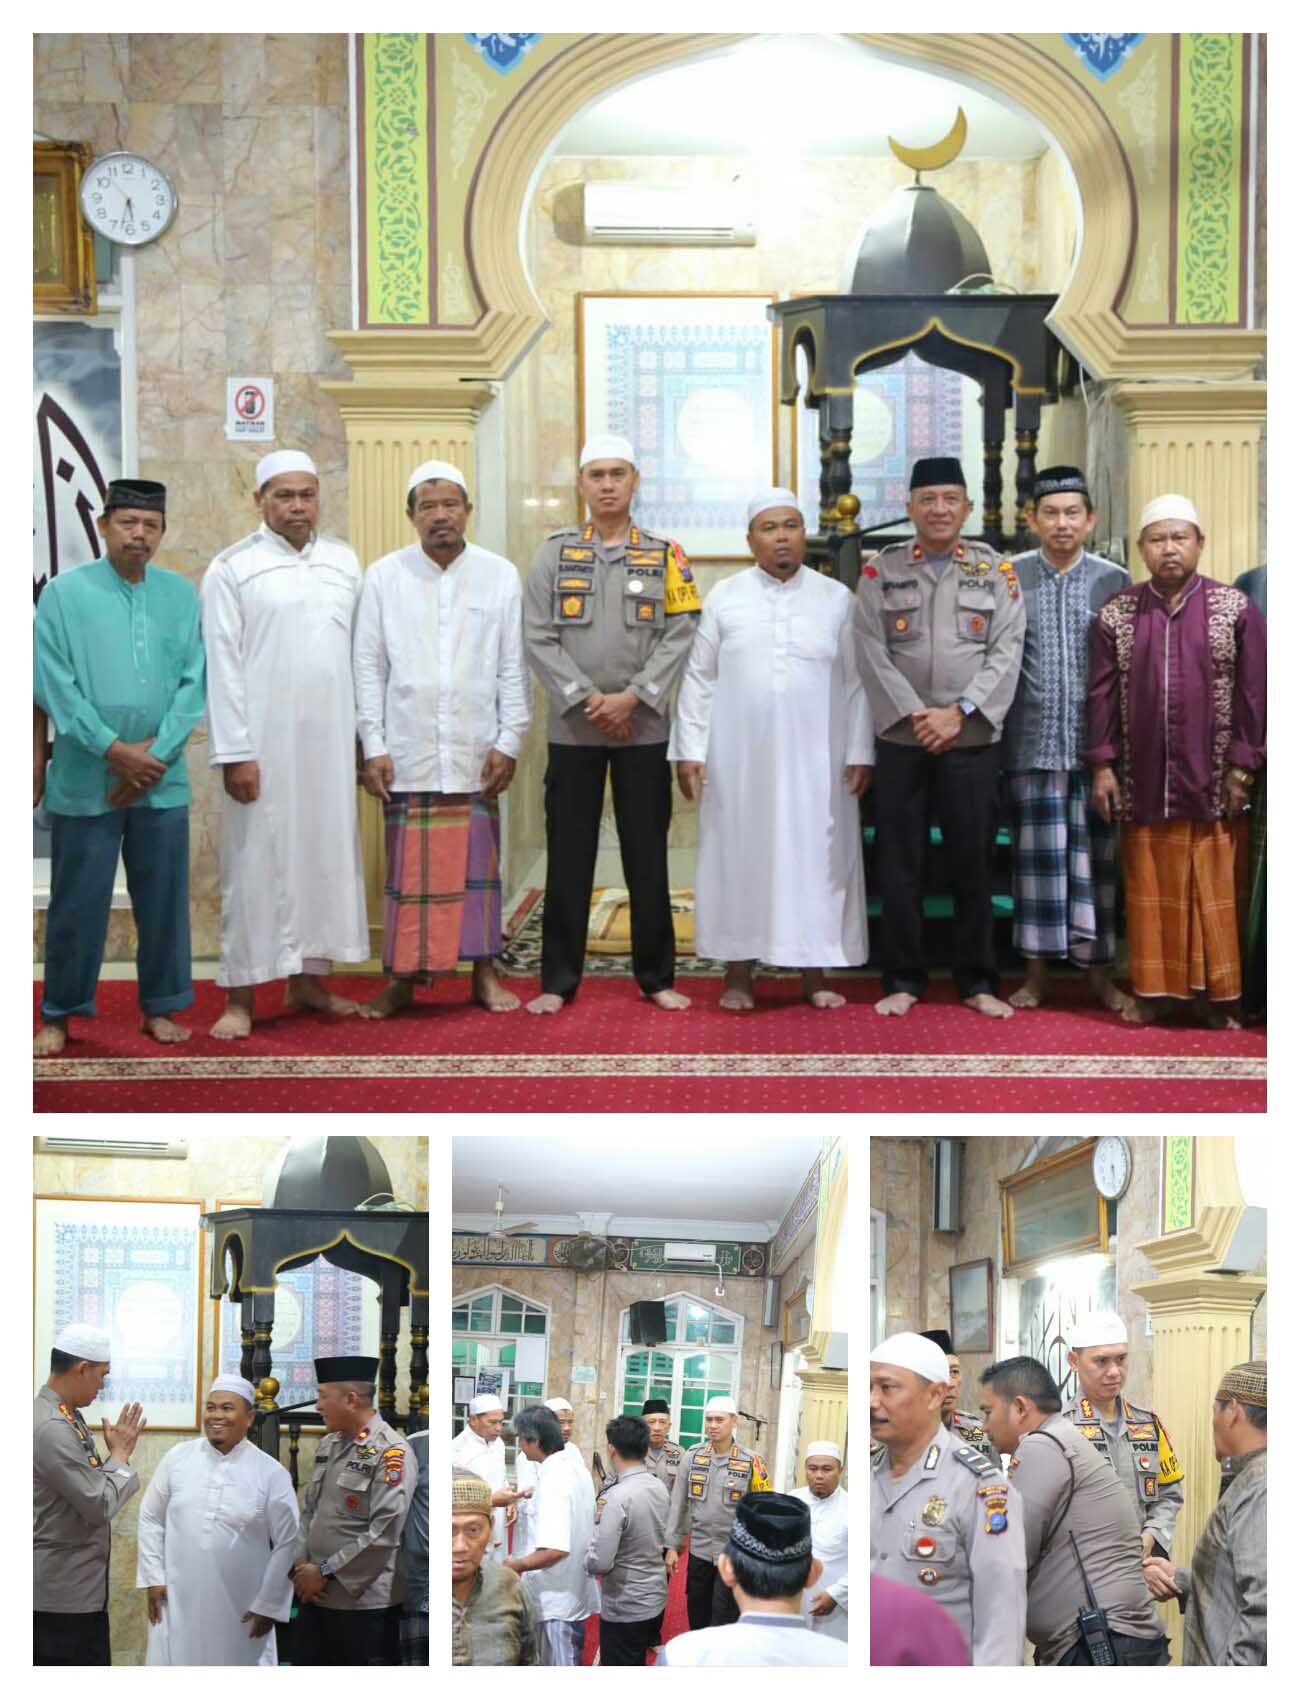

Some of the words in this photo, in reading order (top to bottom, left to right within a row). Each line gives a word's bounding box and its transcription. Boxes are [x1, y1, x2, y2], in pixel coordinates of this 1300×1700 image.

[108, 167, 118, 177] 11
[121, 162, 134, 174] 12
[96, 176, 112, 189] 10
[151, 179, 161, 191] 2
[92, 192, 103, 205] 9
[155, 194, 165, 206] 3
[96, 207, 106, 219] 8
[152, 210, 161, 220] 4
[108, 219, 118, 231] 7
[124, 223, 136, 236] 6
[141, 221, 151, 232] 5
[627, 568, 663, 577] POLRI
[958, 580, 994, 590] POLRI
[1132, 1443, 1158, 1452] POLRI
[345, 1461, 371, 1474] POLRI
[728, 1471, 748, 1479] POLRI
